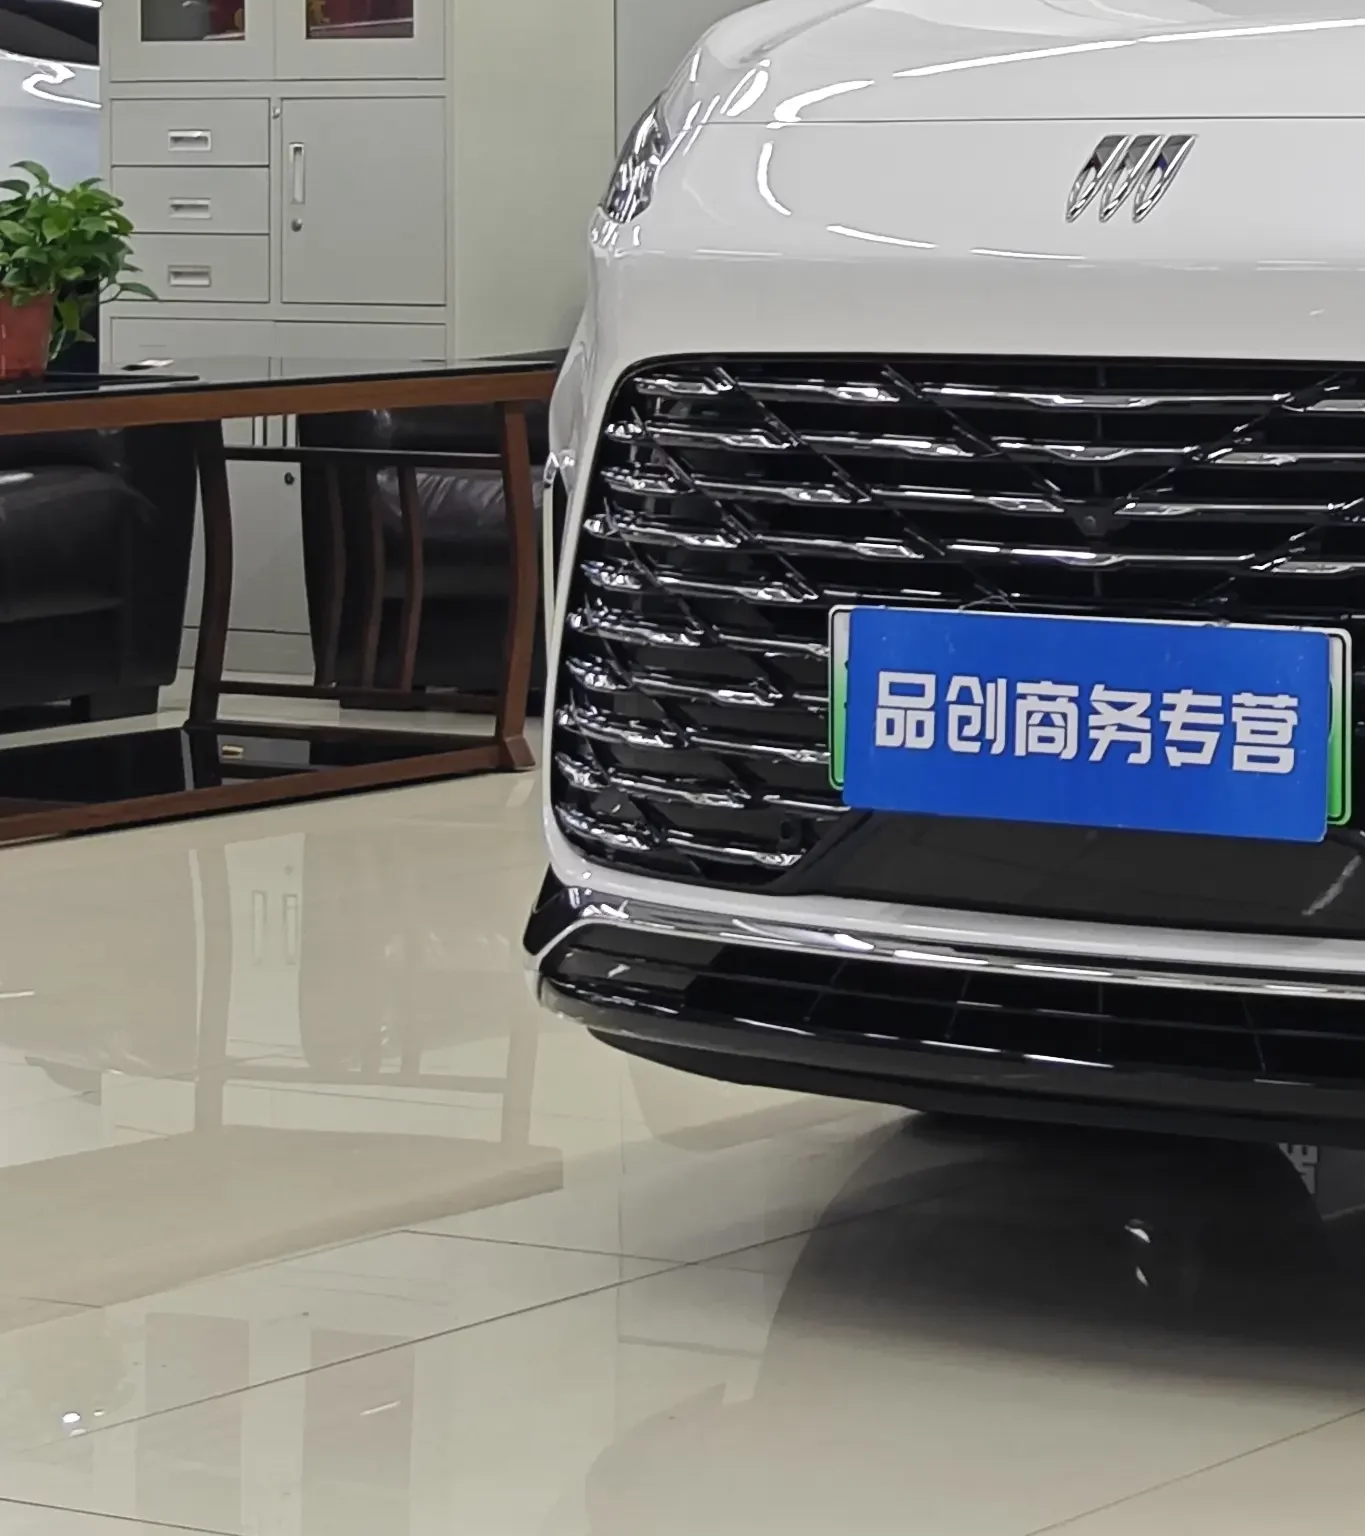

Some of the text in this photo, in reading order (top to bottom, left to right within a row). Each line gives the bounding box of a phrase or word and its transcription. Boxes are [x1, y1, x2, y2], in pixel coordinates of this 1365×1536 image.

[875, 670, 1299, 774] 品创商务专营
